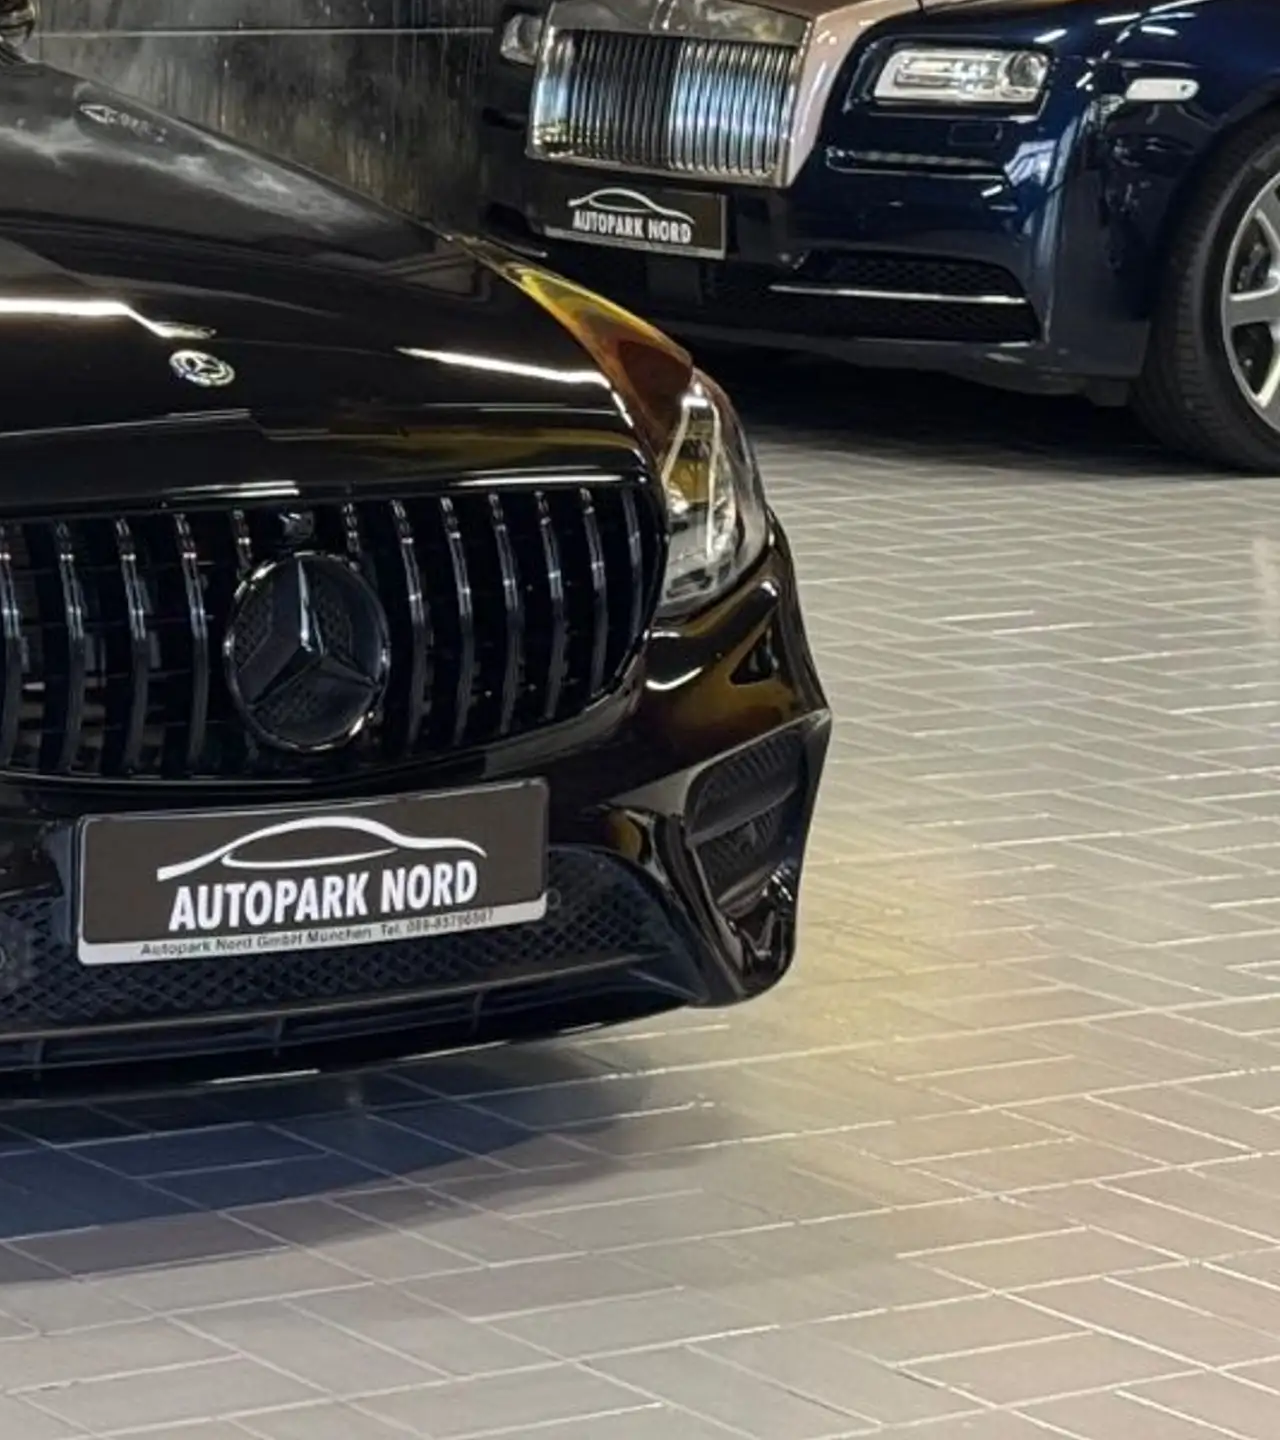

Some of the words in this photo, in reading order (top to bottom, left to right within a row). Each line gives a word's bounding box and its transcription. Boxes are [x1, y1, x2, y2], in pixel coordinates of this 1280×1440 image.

[572, 210, 644, 238] AUTOPARK
[648, 219, 692, 244] NORD
[168, 872, 369, 931] AUTOPARK
[381, 860, 477, 913] NORD
[141, 938, 211, 956] Autopark
[215, 936, 252, 950] Nord
